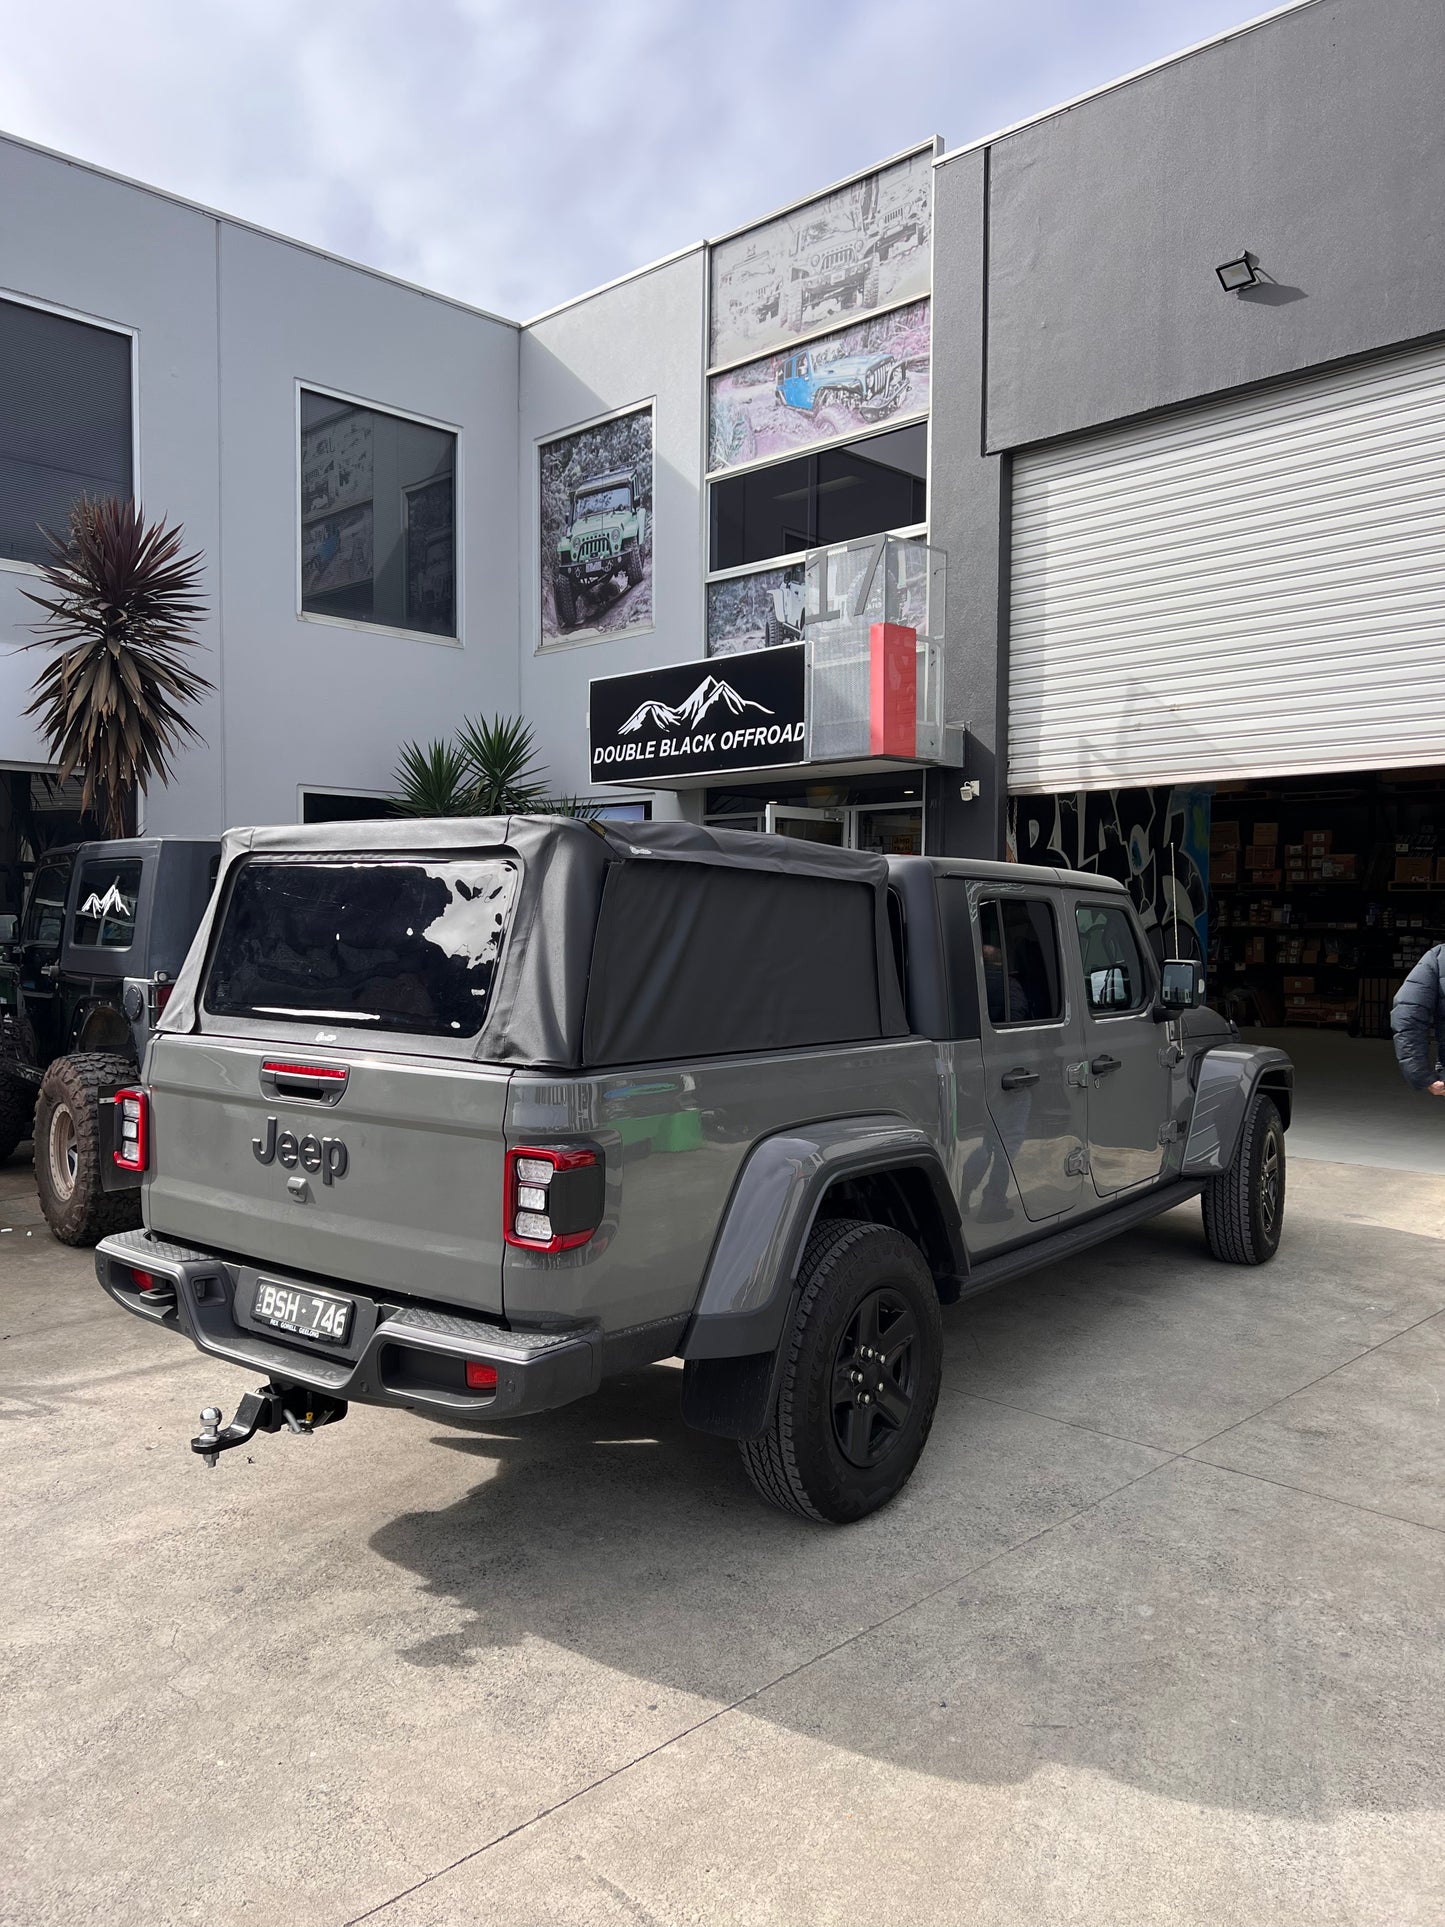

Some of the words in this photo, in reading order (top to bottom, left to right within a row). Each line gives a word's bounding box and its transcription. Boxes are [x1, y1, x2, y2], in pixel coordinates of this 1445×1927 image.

[805, 533, 886, 625] 17
[593, 740, 656, 764] DOUBLE
[659, 733, 717, 758] BLACK
[720, 722, 805, 750] OFFROAD
[252, 1116, 348, 1186] Jeep
